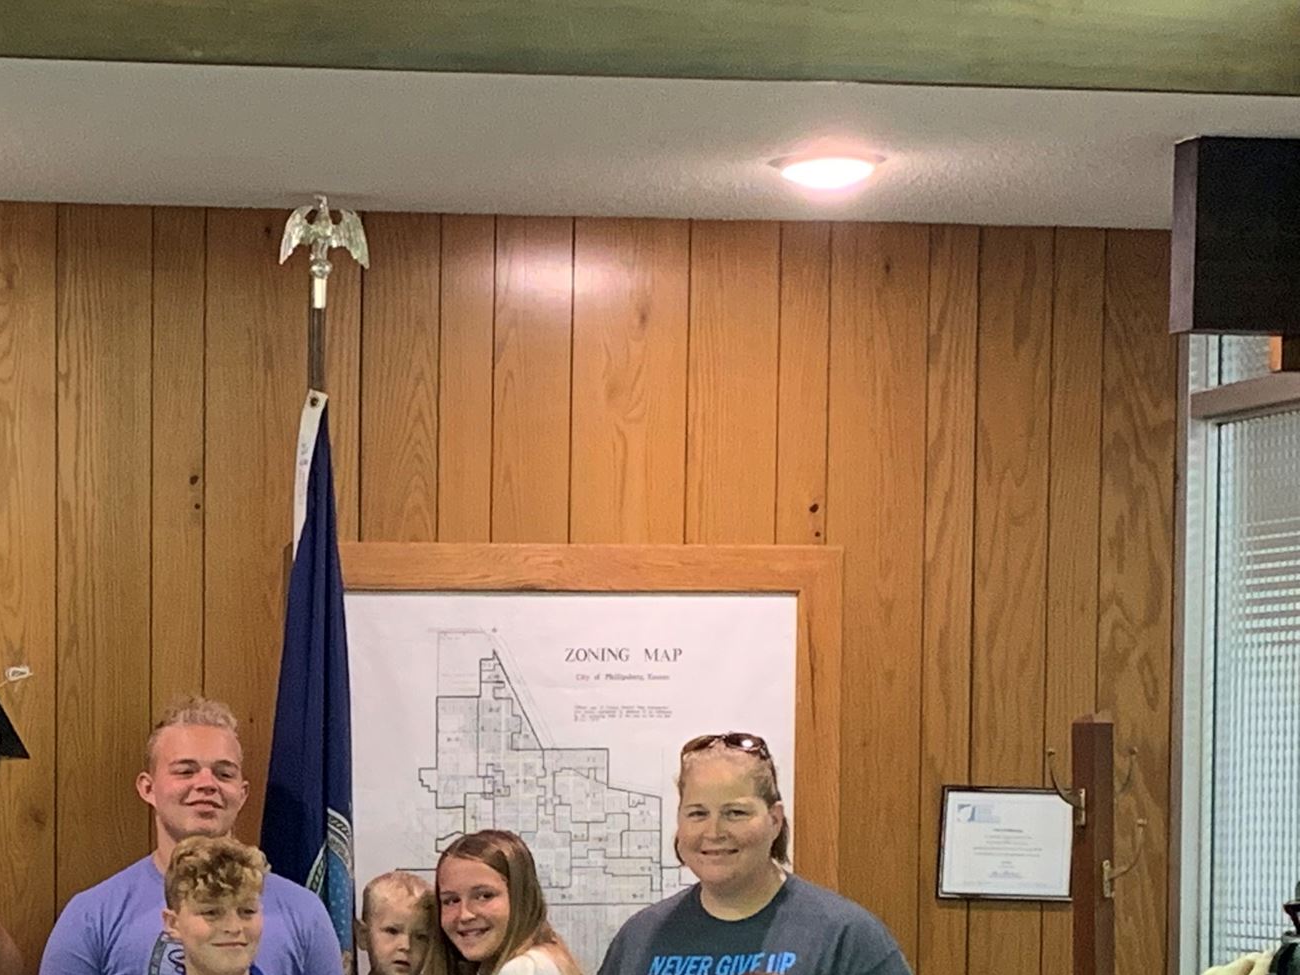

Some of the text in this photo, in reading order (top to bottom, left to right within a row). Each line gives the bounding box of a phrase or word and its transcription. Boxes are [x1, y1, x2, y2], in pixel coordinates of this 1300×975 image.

[564, 647, 683, 663] ZONING MAP
[766, 951, 797, 975] UP
